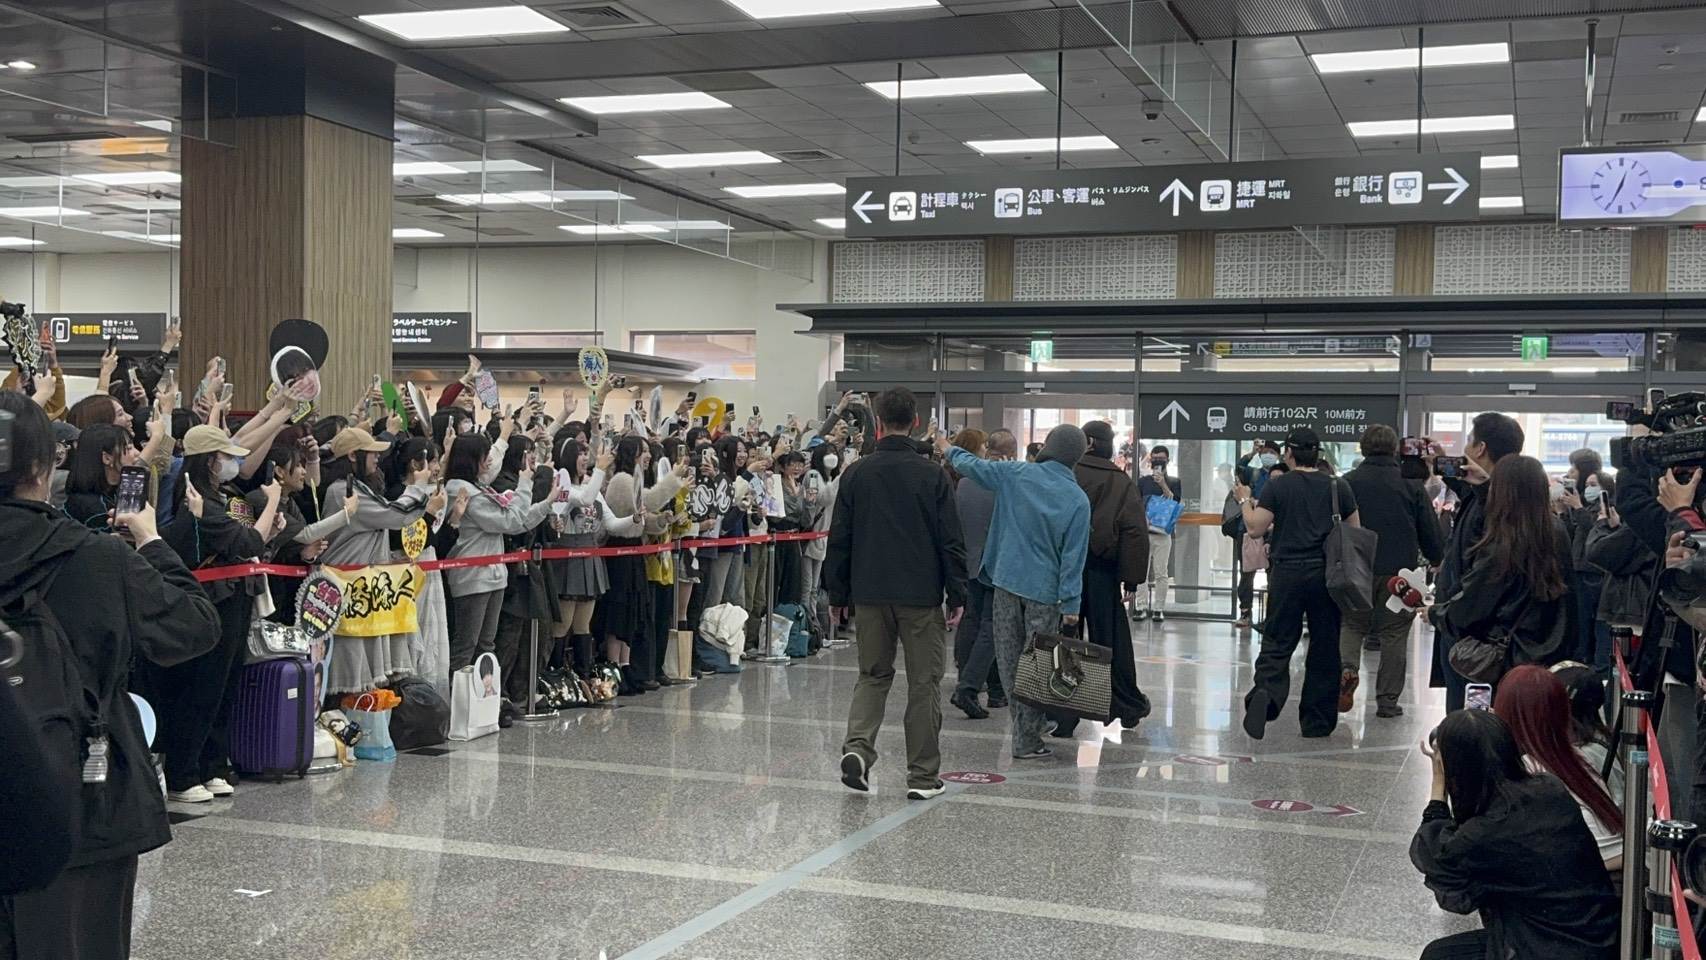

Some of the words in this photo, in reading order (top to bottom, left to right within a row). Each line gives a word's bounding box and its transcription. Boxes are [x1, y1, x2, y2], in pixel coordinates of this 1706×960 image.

[1236, 180, 1266, 197] 捷運
[1268, 180, 1286, 188] MRT
[1352, 175, 1384, 192] 銀行
[920, 192, 959, 208] 計程車
[1236, 199, 1256, 208] MRT
[1360, 194, 1383, 204] Bank
[1027, 207, 1042, 215] Bus
[1324, 409, 1367, 420] 10M前方
[1243, 422, 1257, 432] Go
[1259, 423, 1289, 432] ahead
